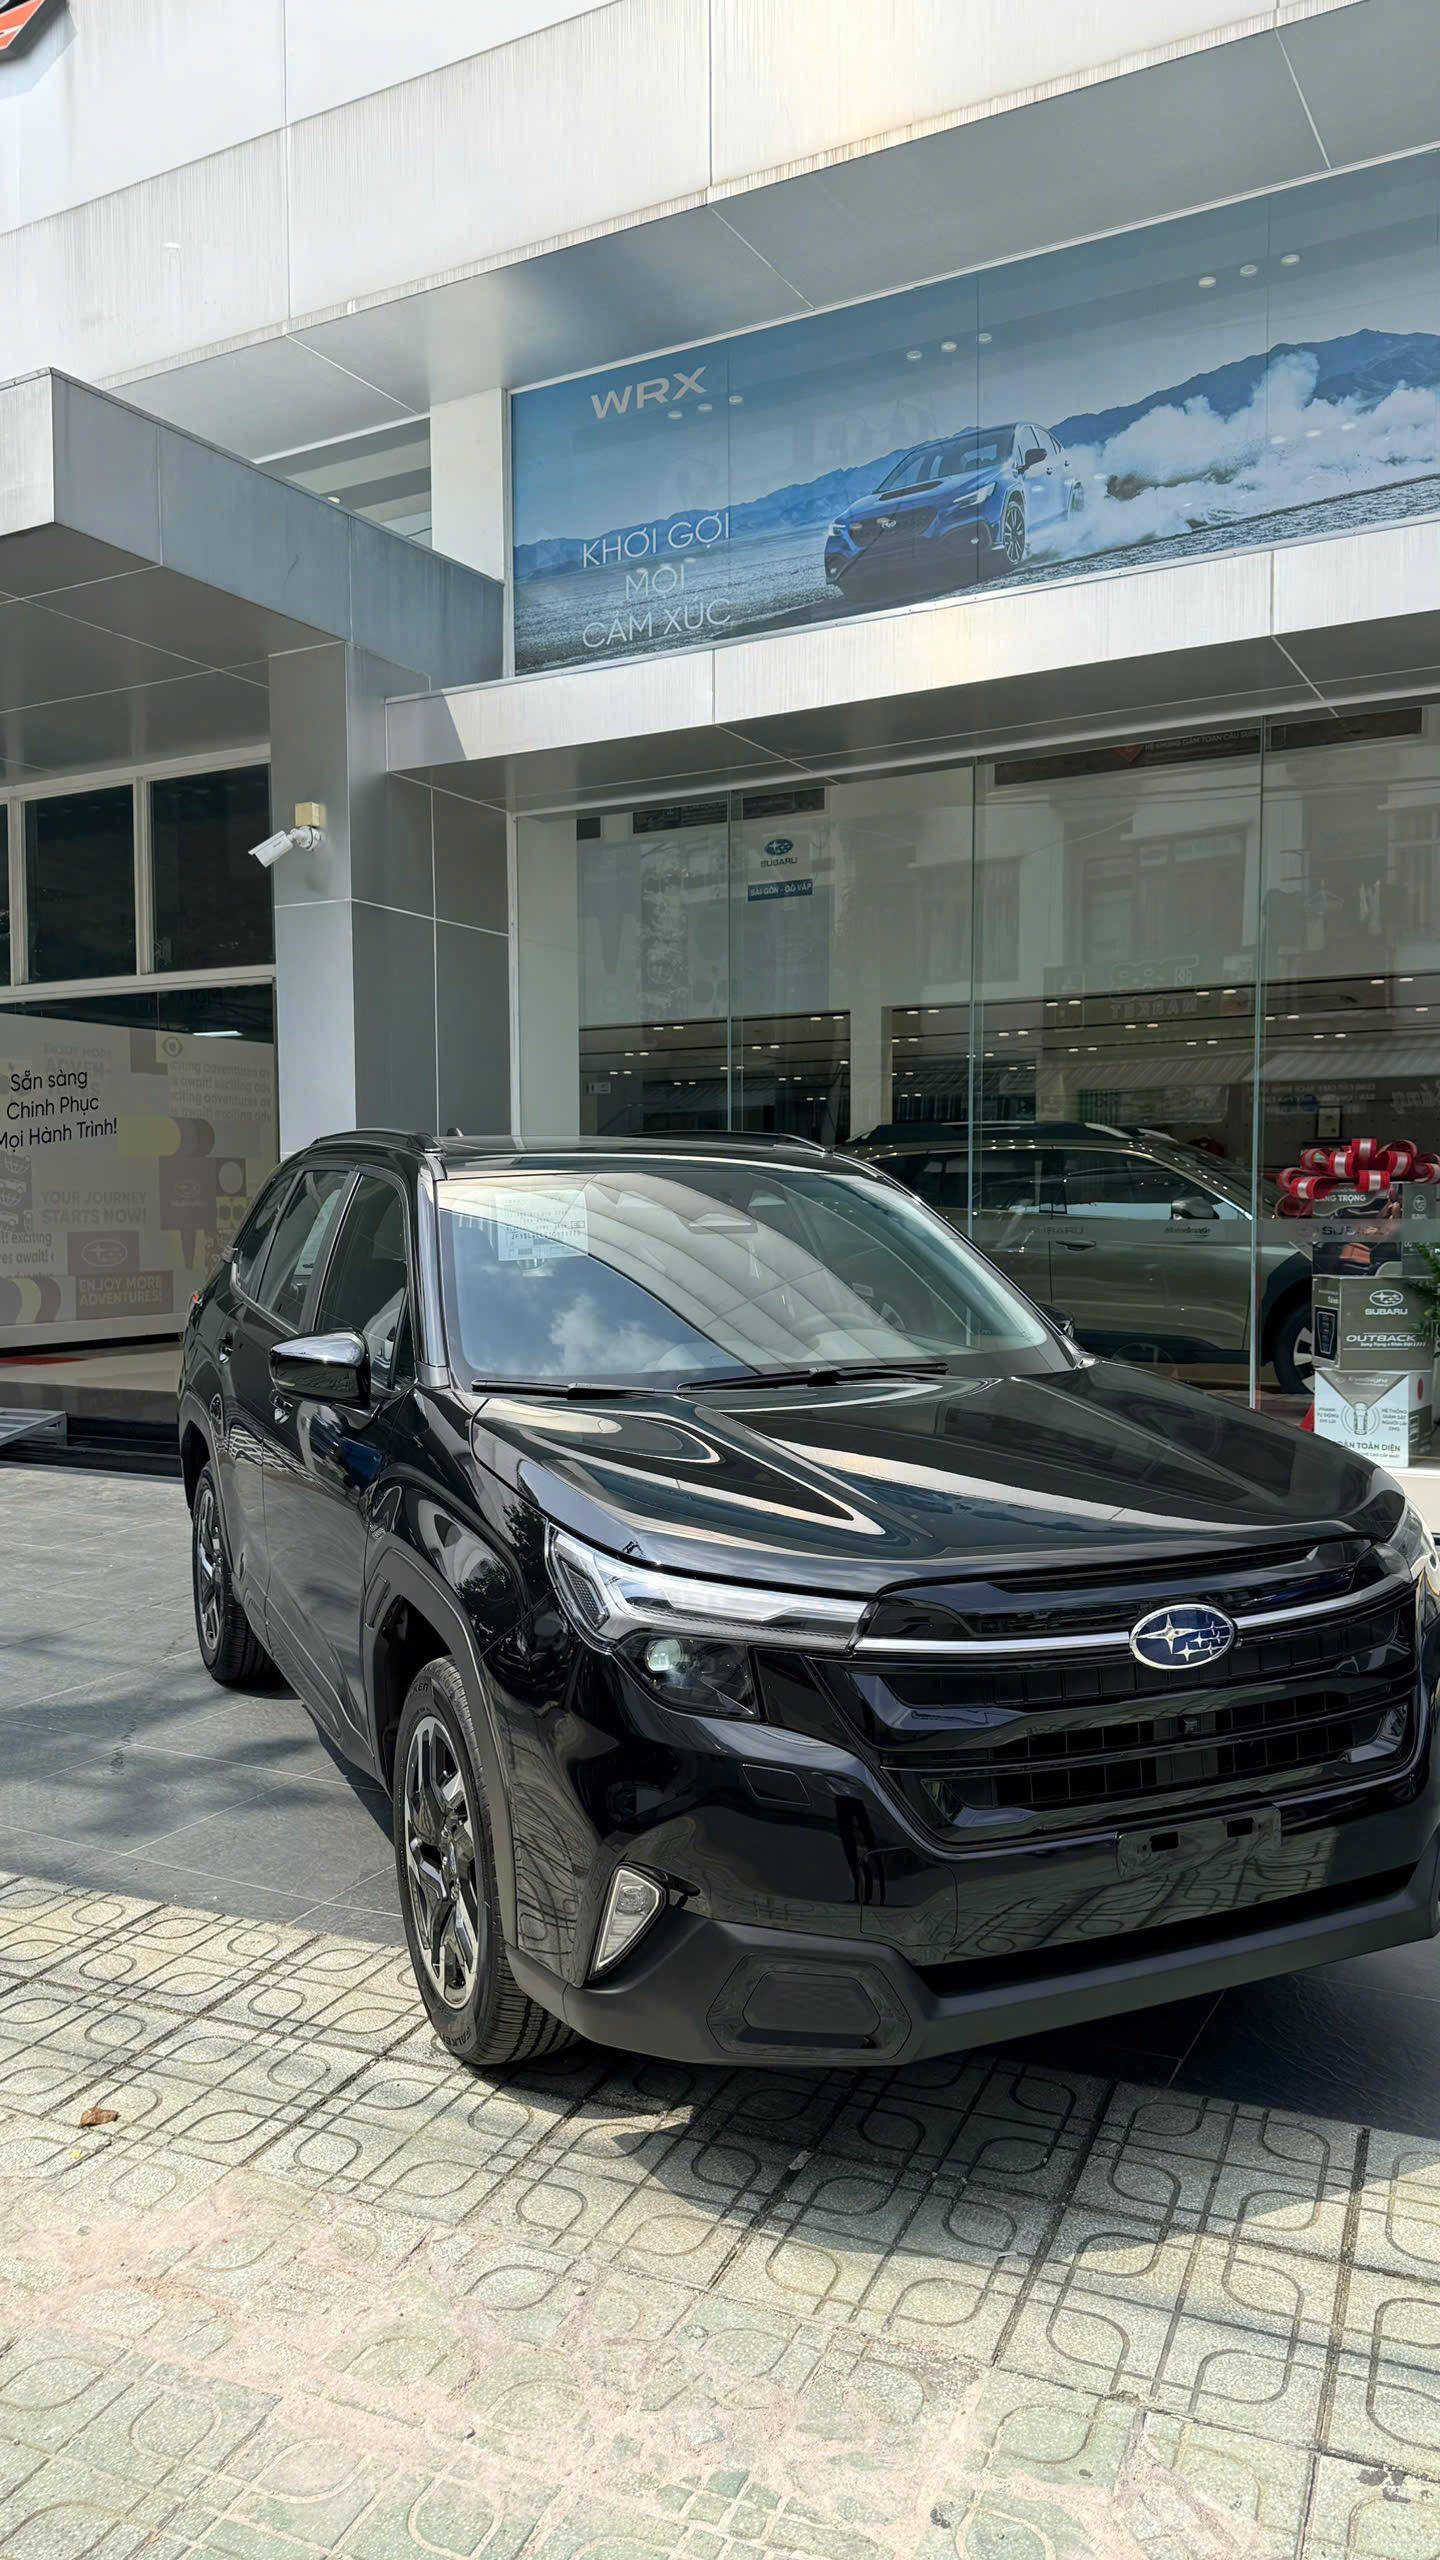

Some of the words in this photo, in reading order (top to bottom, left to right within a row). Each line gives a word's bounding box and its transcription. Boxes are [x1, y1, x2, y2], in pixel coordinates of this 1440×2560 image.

[591, 366, 707, 419] WRX
[583, 527, 657, 568] KHƠI
[668, 512, 729, 549] GỢI
[625, 563, 685, 600] MỌI
[582, 610, 652, 648] CẢM
[664, 596, 731, 634] XÚC
[760, 857, 798, 868] SUBARU
[10, 1070, 43, 1092] Sẵn
[48, 1069, 88, 1089] sàng
[6, 1098, 55, 1120] Chinh
[60, 1095, 99, 1116] Phục
[29, 1124, 72, 1146] Hành
[76, 1117, 117, 1139] Trình!
[40, 1191, 81, 1205] YOUR
[1338, 1194, 1367, 1204] TRỌNG
[42, 1208, 100, 1225] STARTS
[103, 1207, 147, 1225] NOW!
[79, 1277, 122, 1293] ENJOY
[126, 1275, 162, 1290] MORE
[1364, 1308, 1408, 1316] SUBARU
[1345, 1334, 1417, 1343] OUTBACK
[1357, 1441, 1380, 1451] TOÀN
[1381, 1443, 1401, 1453] DIỆN
